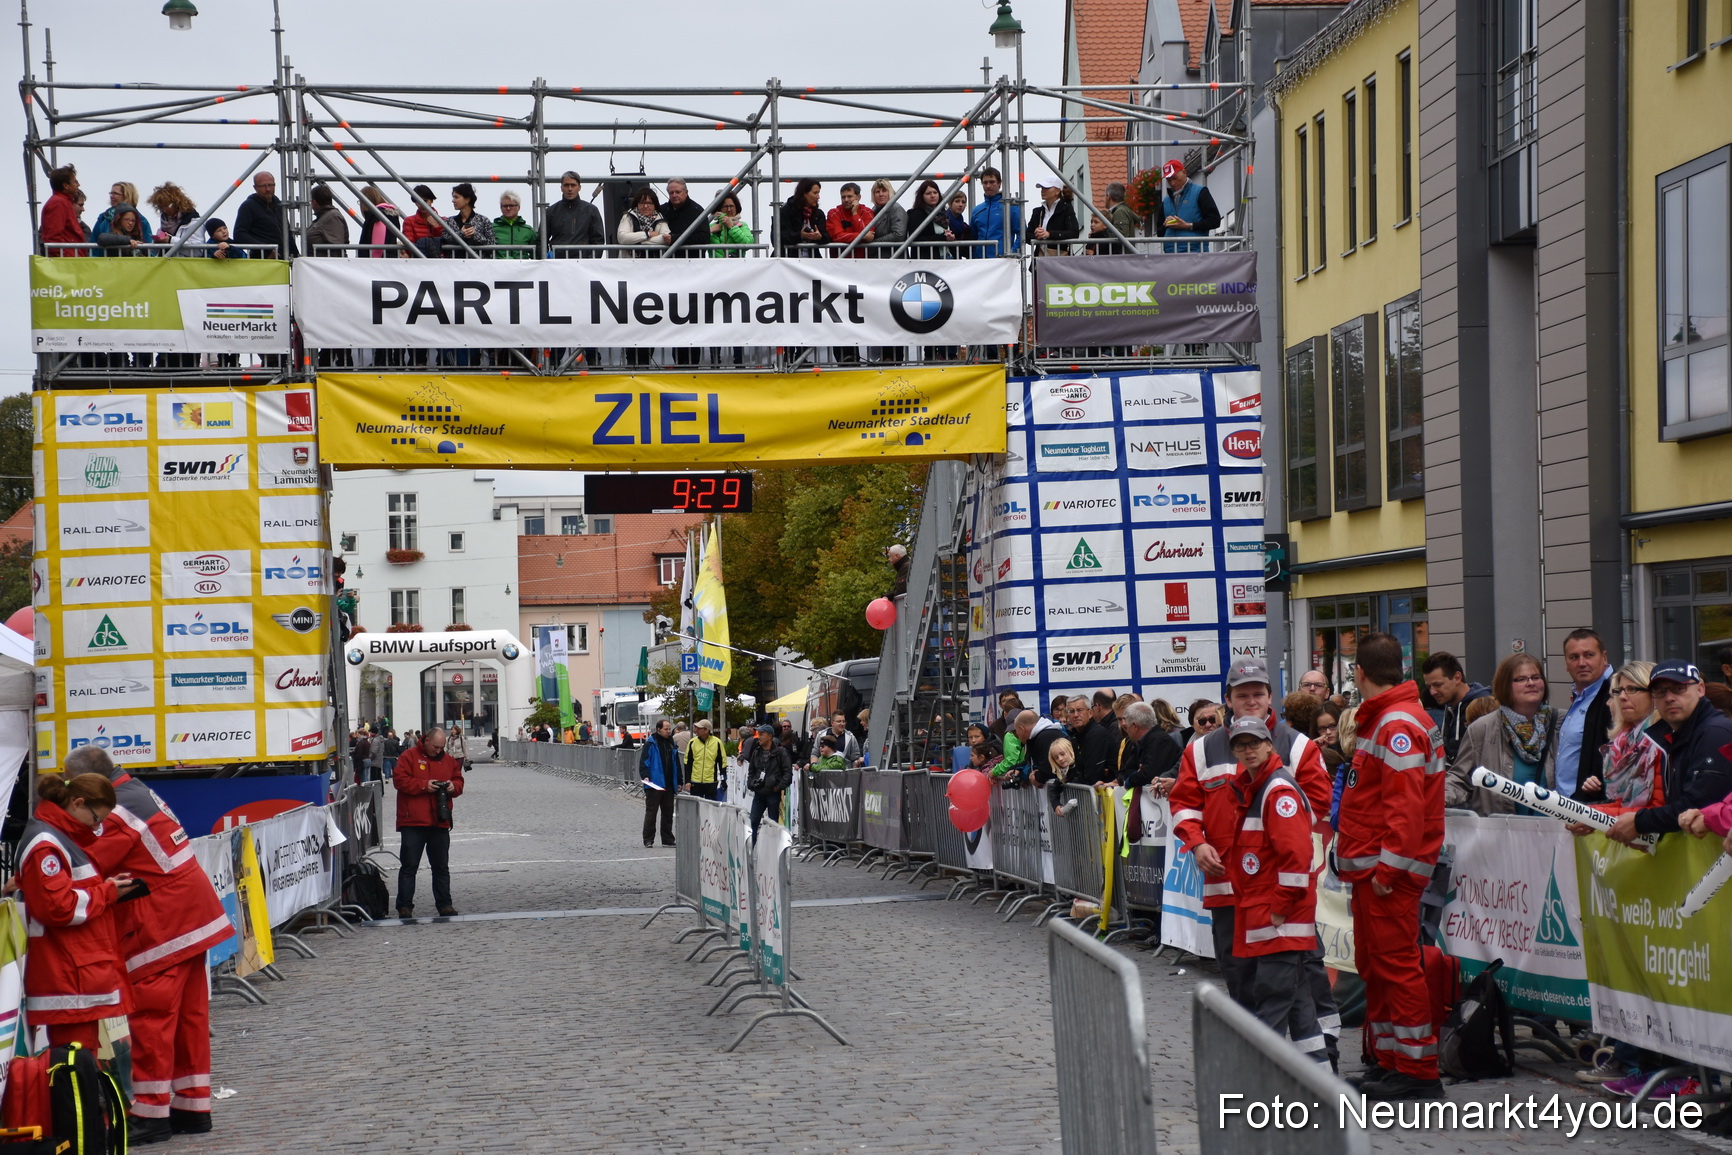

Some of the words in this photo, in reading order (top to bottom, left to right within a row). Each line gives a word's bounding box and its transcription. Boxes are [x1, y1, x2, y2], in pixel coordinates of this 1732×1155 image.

[894, 272, 949, 293] BMW
[71, 285, 104, 298] wo's
[1048, 284, 1153, 306] BOCK
[1167, 283, 1217, 296] OFFICE
[372, 280, 572, 325] PARTL
[591, 279, 865, 325] Neumarkt
[55, 301, 149, 322] langgeht!
[1045, 309, 1081, 318] inspired
[1082, 309, 1092, 318] by
[1095, 308, 1120, 317] smart
[1122, 307, 1160, 317] concepts
[203, 320, 277, 332] NeuerMarkt
[1124, 397, 1177, 407] RAIL.ONE
[1239, 398, 1256, 409] DEHN
[593, 392, 745, 446] ZIEL
[1065, 410, 1081, 418] KIA
[828, 416, 906, 430] Neumarkter
[910, 413, 972, 426] Stadtlauf
[104, 424, 143, 433] energie
[356, 422, 438, 434] Neumarkter
[442, 424, 506, 436] Stadtlauf
[1044, 446, 1080, 455] Neumarkter
[1080, 445, 1106, 453] Tagblatt
[1130, 440, 1201, 457] NATHUS
[86, 453, 117, 472] RUND
[163, 460, 217, 475] swn
[86, 471, 121, 487] SCHAU
[673, 478, 741, 509] 9:29
[1223, 490, 1262, 504] swn
[1062, 498, 1117, 510] VARIOTEC
[1172, 504, 1207, 514] energie
[264, 519, 319, 528] RAIL.ONE
[63, 525, 121, 535] RAIL.ONE
[1143, 540, 1205, 562] Charivari
[1229, 543, 1258, 551] Neumarkter
[183, 559, 220, 567] GERHART
[87, 575, 147, 586] VARIOTEC
[199, 583, 218, 591] KIA
[1048, 606, 1103, 616] RAIL.ONE
[1166, 604, 1188, 614] Braun
[292, 616, 313, 624] MINI
[210, 634, 249, 643] energie
[369, 640, 415, 654] BMW
[419, 638, 496, 654] Laufsport
[1052, 651, 1101, 666] swn
[1155, 663, 1206, 673] Lammsbräu
[175, 676, 214, 684] Neumarkter
[215, 674, 244, 684] Tagblatt
[69, 686, 126, 697] RAIL.ONE
[191, 730, 252, 742] VARIOTEC
[113, 745, 152, 756] energie
[1622, 898, 1655, 929] weiß,
[1658, 901, 1683, 930] wo's
[1644, 935, 1710, 987] langgeht!
